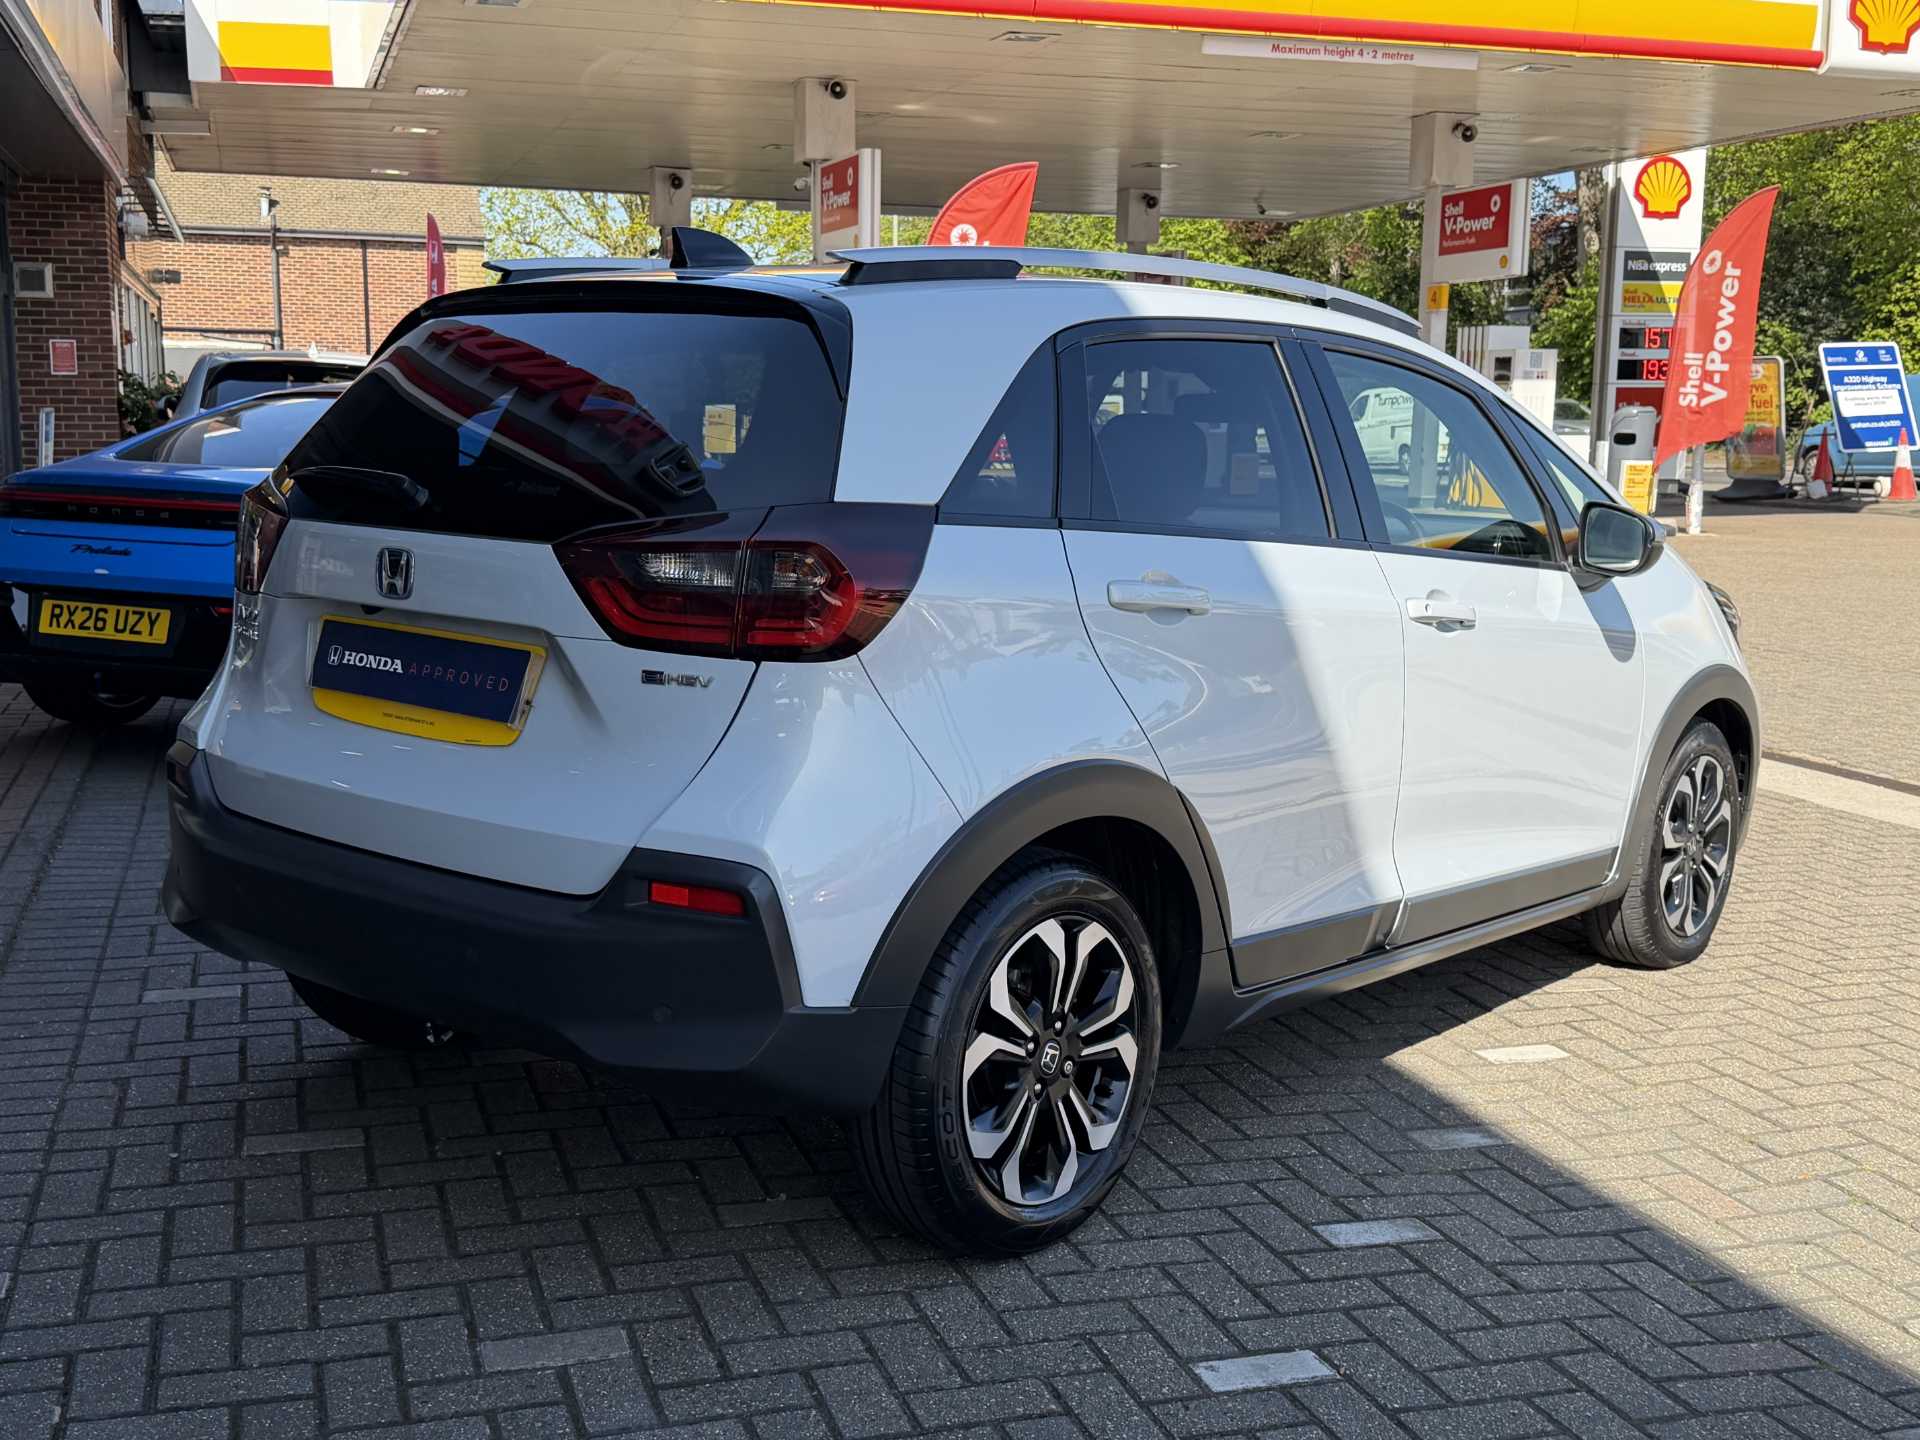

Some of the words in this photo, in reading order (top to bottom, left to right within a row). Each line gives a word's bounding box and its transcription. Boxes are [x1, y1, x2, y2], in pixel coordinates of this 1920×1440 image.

[1271, 43, 1321, 55] Maximum
[1324, 45, 1355, 59] height
[1381, 51, 1414, 61] metres
[1444, 200, 1464, 217] Shell
[1627, 258, 1649, 271] Nisa
[1649, 261, 1687, 274] express
[1430, 290, 1438, 305] 4
[1644, 328, 1673, 349] 157
[1700, 261, 1742, 407] V-Power
[1678, 352, 1704, 407] Shell
[1862, 375, 1888, 386] Highway
[1751, 395, 1773, 409] fuel
[67, 504, 169, 518] HONDA
[69, 543, 132, 557] Prelude
[48, 603, 109, 632] RX26
[113, 608, 161, 637] UZY
[342, 650, 404, 673] HONDA
[408, 662, 510, 693] APPROVED
